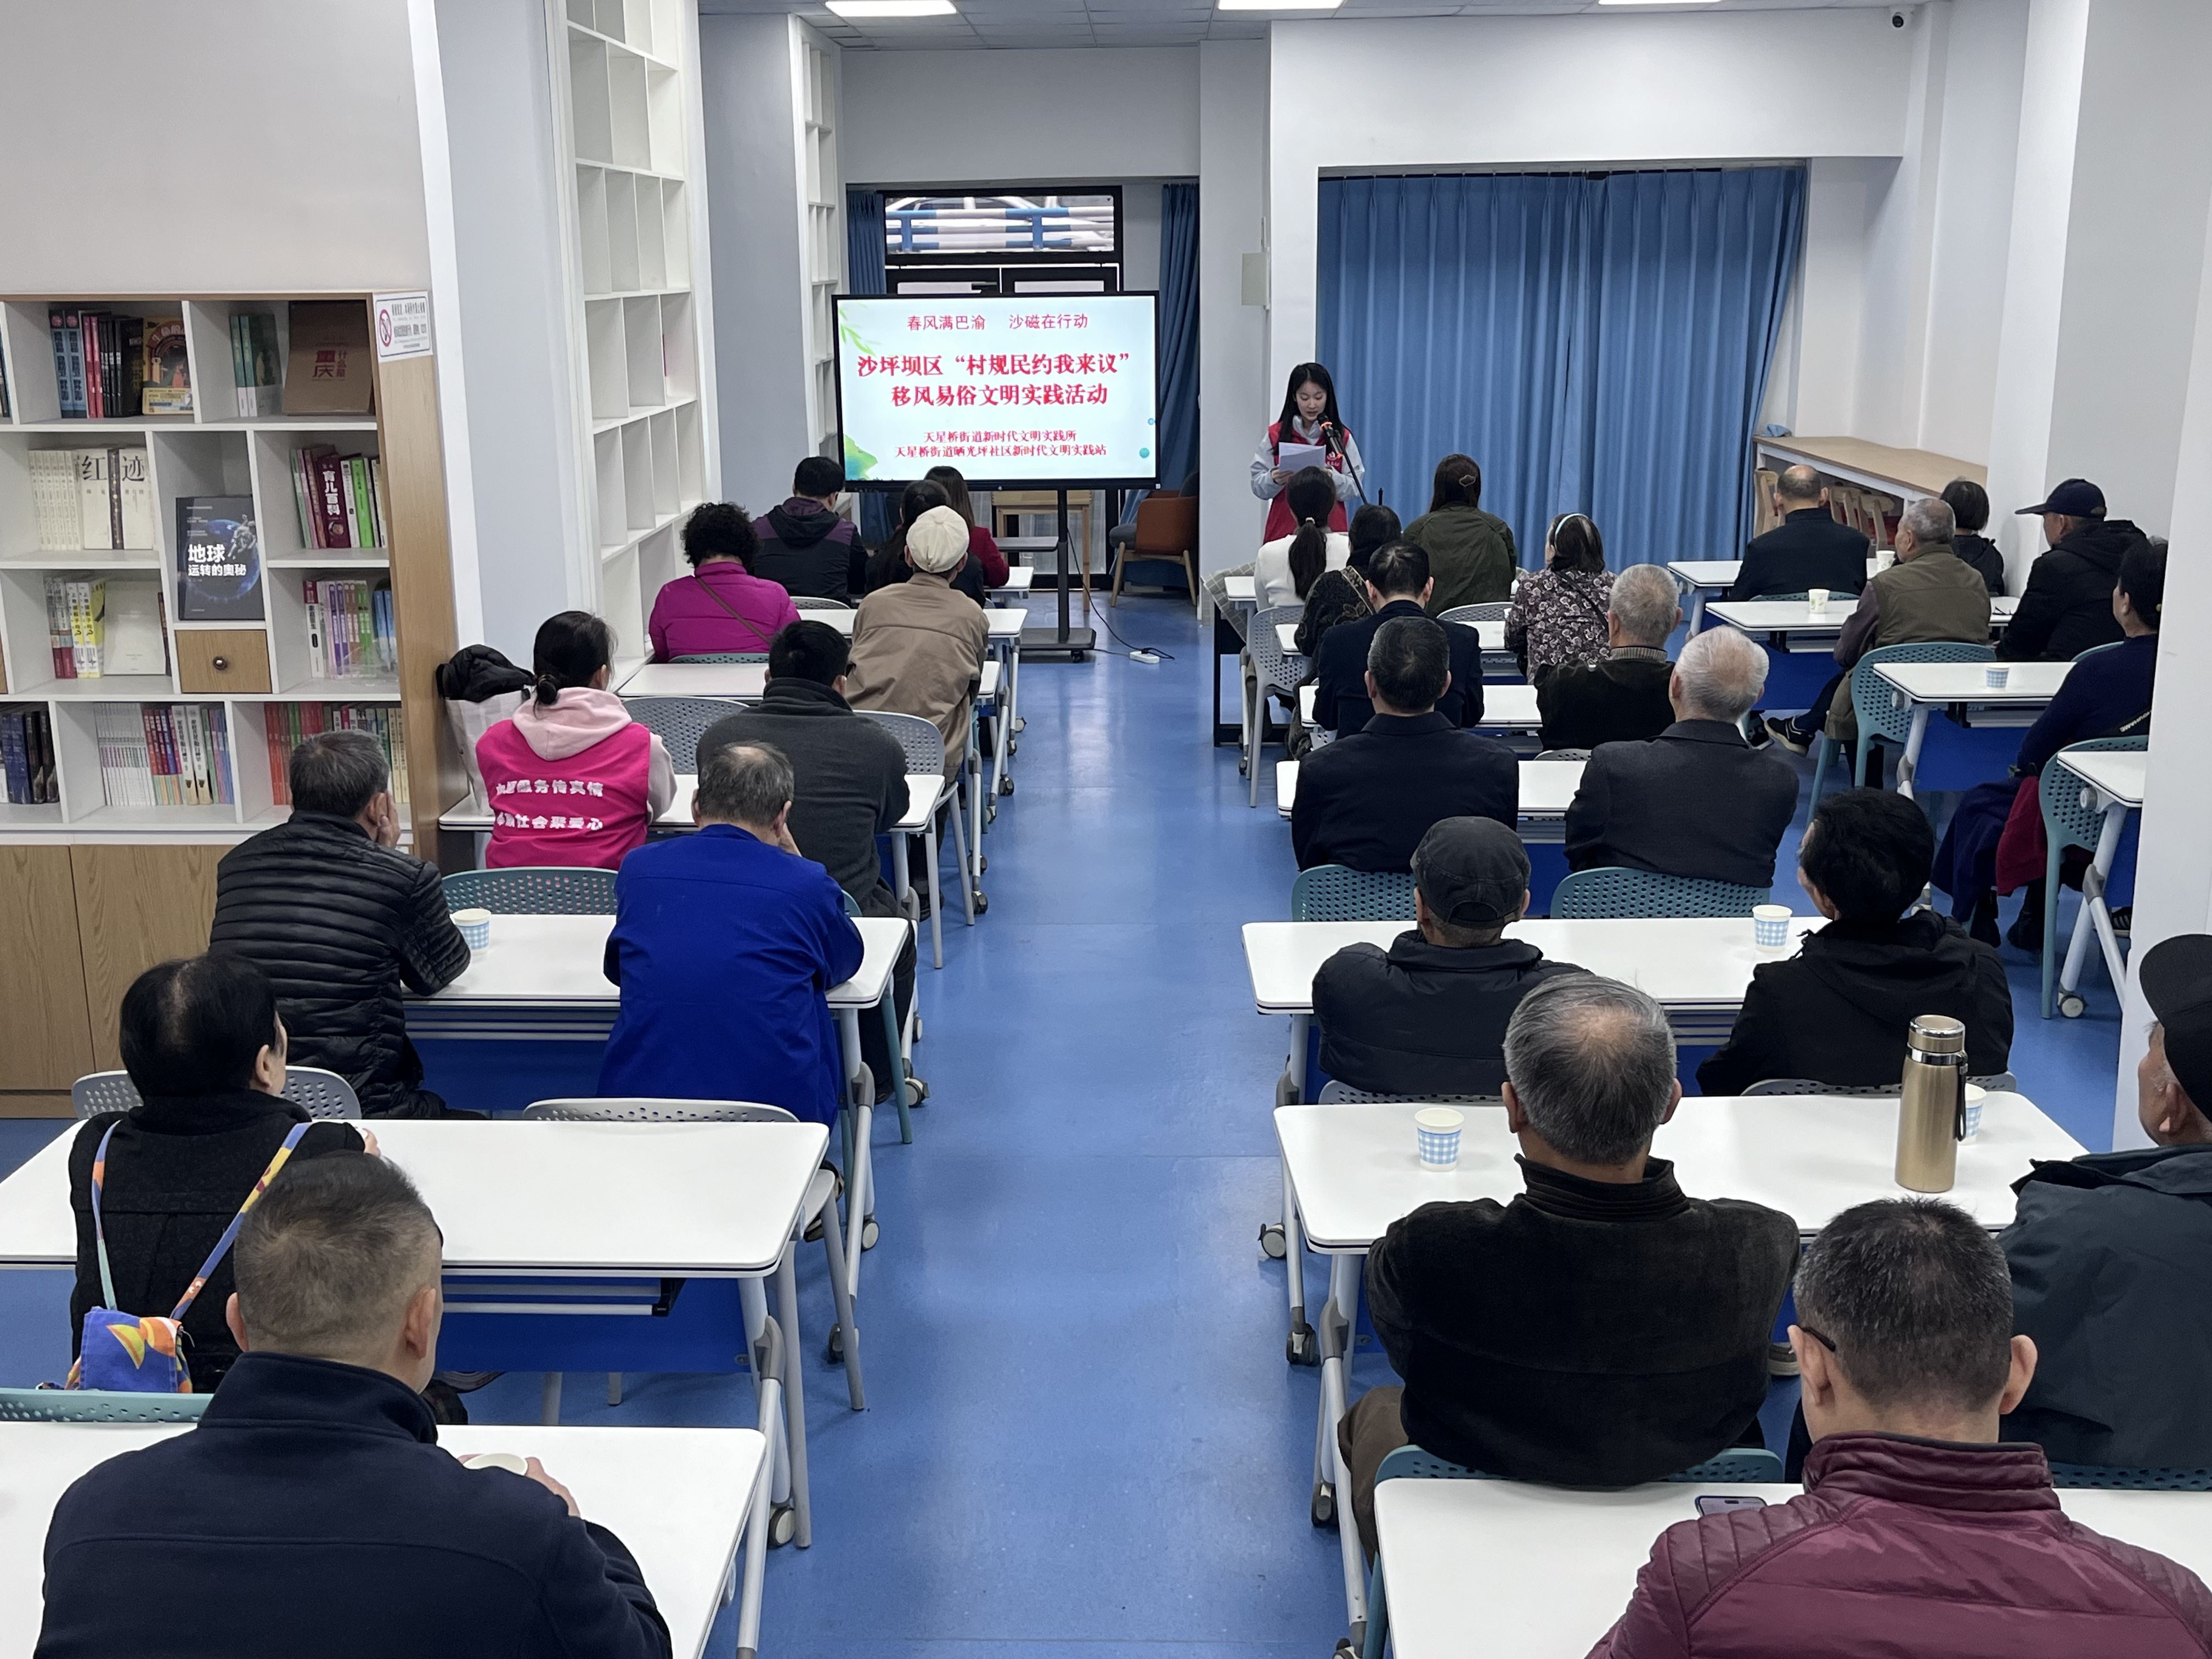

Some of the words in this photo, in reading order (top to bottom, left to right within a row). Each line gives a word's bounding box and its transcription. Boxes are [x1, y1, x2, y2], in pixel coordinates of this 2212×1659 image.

[908, 315, 985, 330] 春风满巴渝
[1009, 314, 1088, 330] 沙磁在行动
[891, 382, 1108, 407] 移风易俗文明实践活动
[923, 430, 1076, 442] 天星桥街道新时代文明实践所
[82, 455, 108, 481] 红
[122, 455, 145, 482] 迹
[188, 543, 225, 563] 地球
[188, 563, 247, 577] 运转的奥秘
